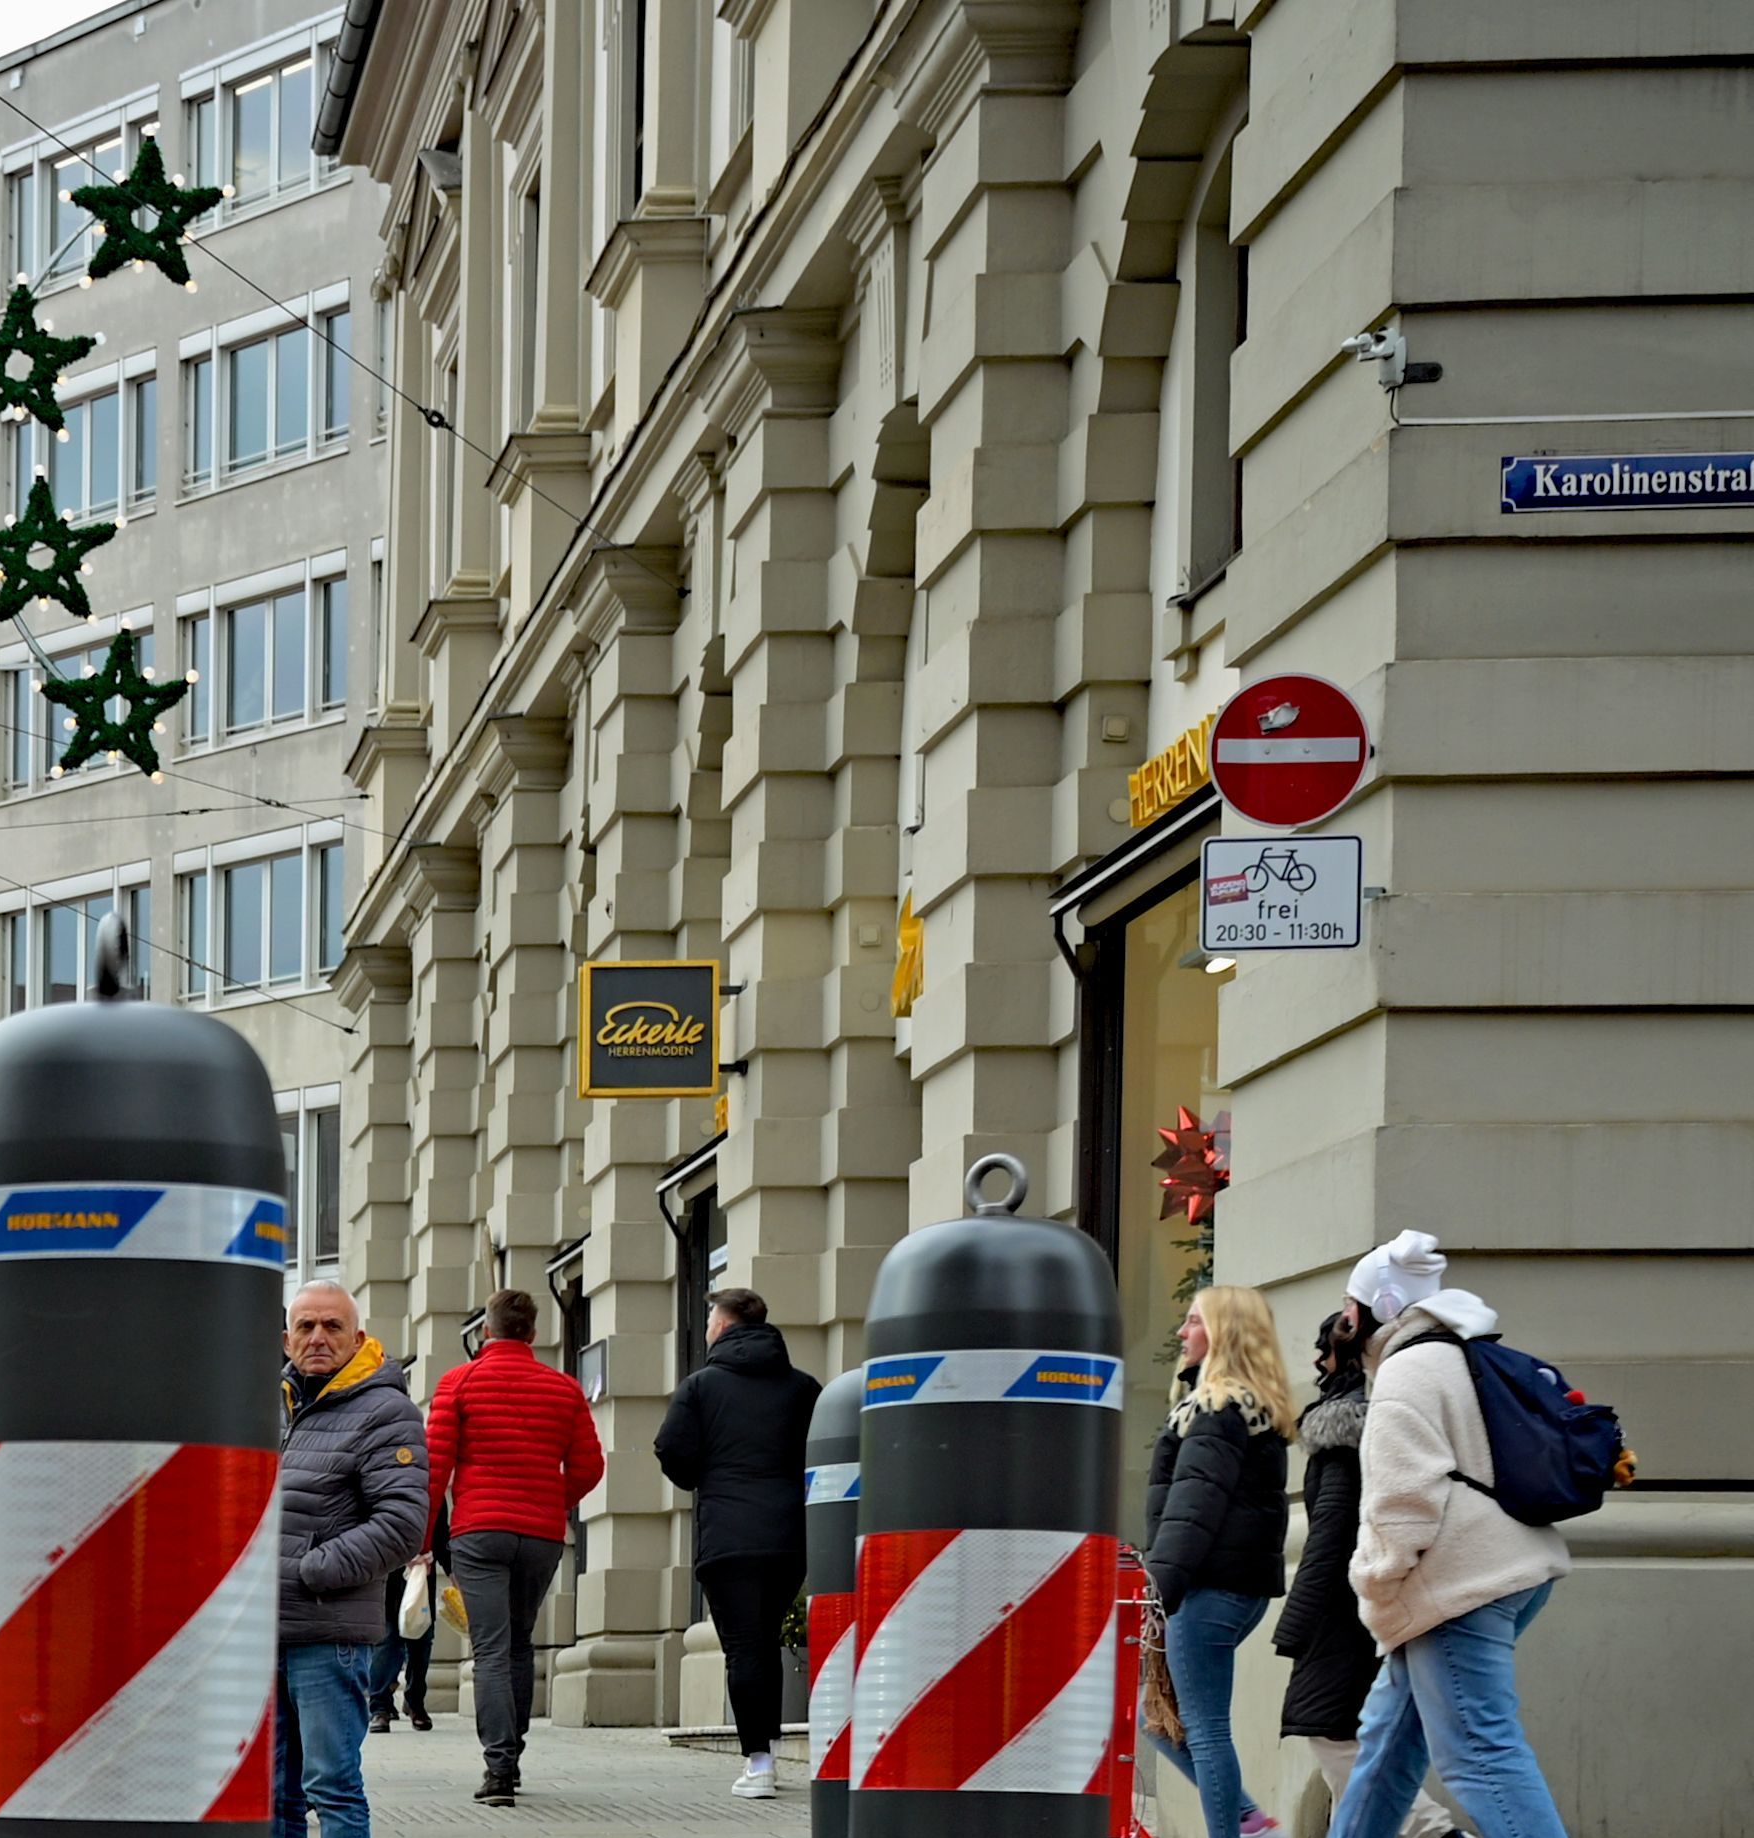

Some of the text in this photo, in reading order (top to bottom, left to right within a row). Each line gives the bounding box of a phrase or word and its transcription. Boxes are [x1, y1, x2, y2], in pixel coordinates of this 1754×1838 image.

[1533, 460, 1754, 497] Karolinenstra
[1128, 706, 1217, 828] HERREN
[1258, 899, 1298, 919] frei
[1216, 924, 1266, 942] 20:30
[1289, 922, 1344, 940] 11:30h
[596, 1001, 705, 1046] Eckerle
[608, 1045, 694, 1057] HERRENMODEN
